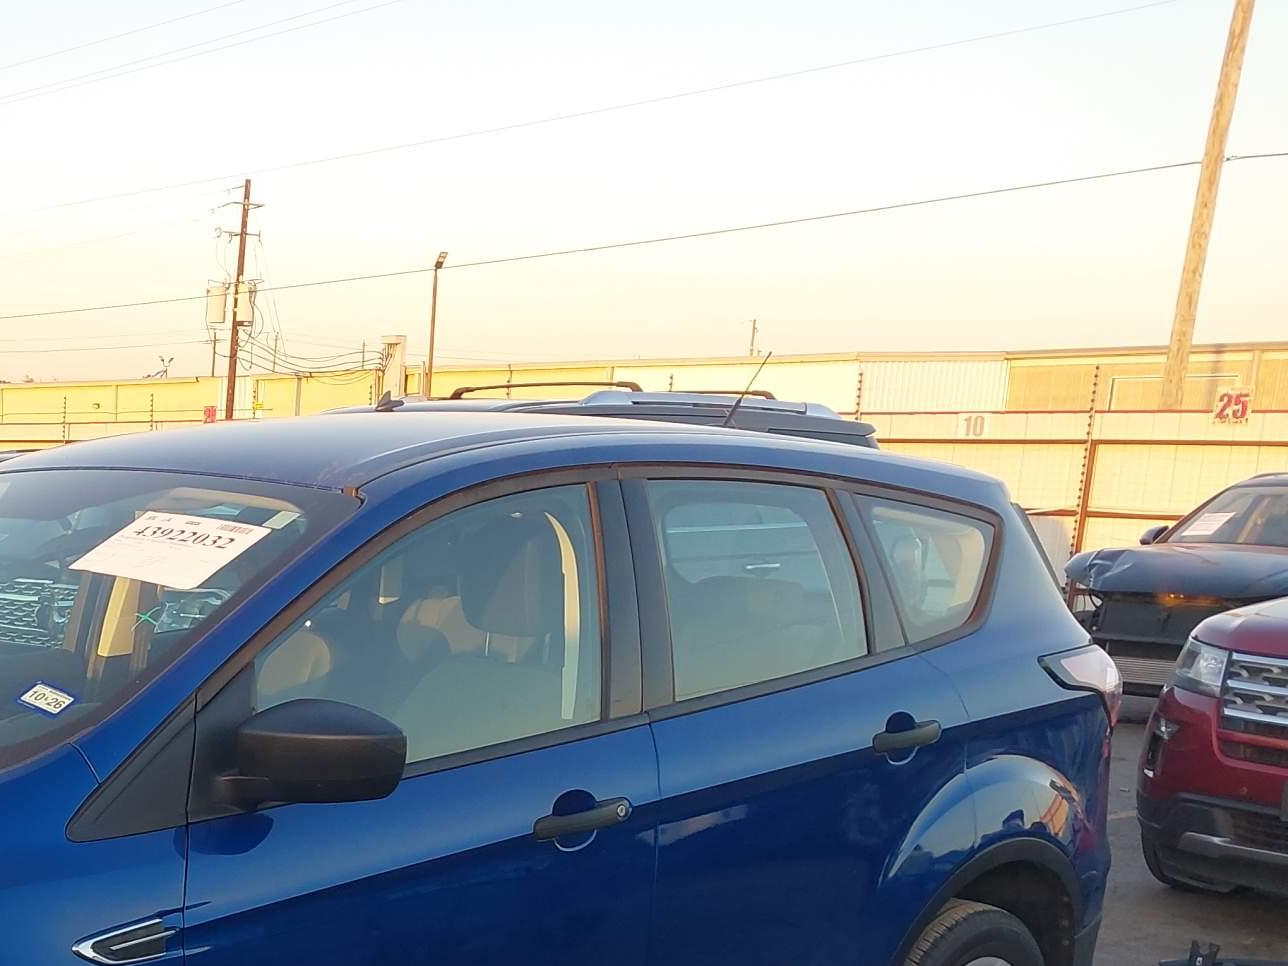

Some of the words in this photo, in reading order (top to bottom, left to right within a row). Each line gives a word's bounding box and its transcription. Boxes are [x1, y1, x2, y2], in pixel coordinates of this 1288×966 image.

[1215, 393, 1250, 420] 25
[963, 415, 985, 437] 10
[134, 525, 236, 549] 43922032
[29, 690, 46, 701] 10
[46, 698, 66, 709] 26
